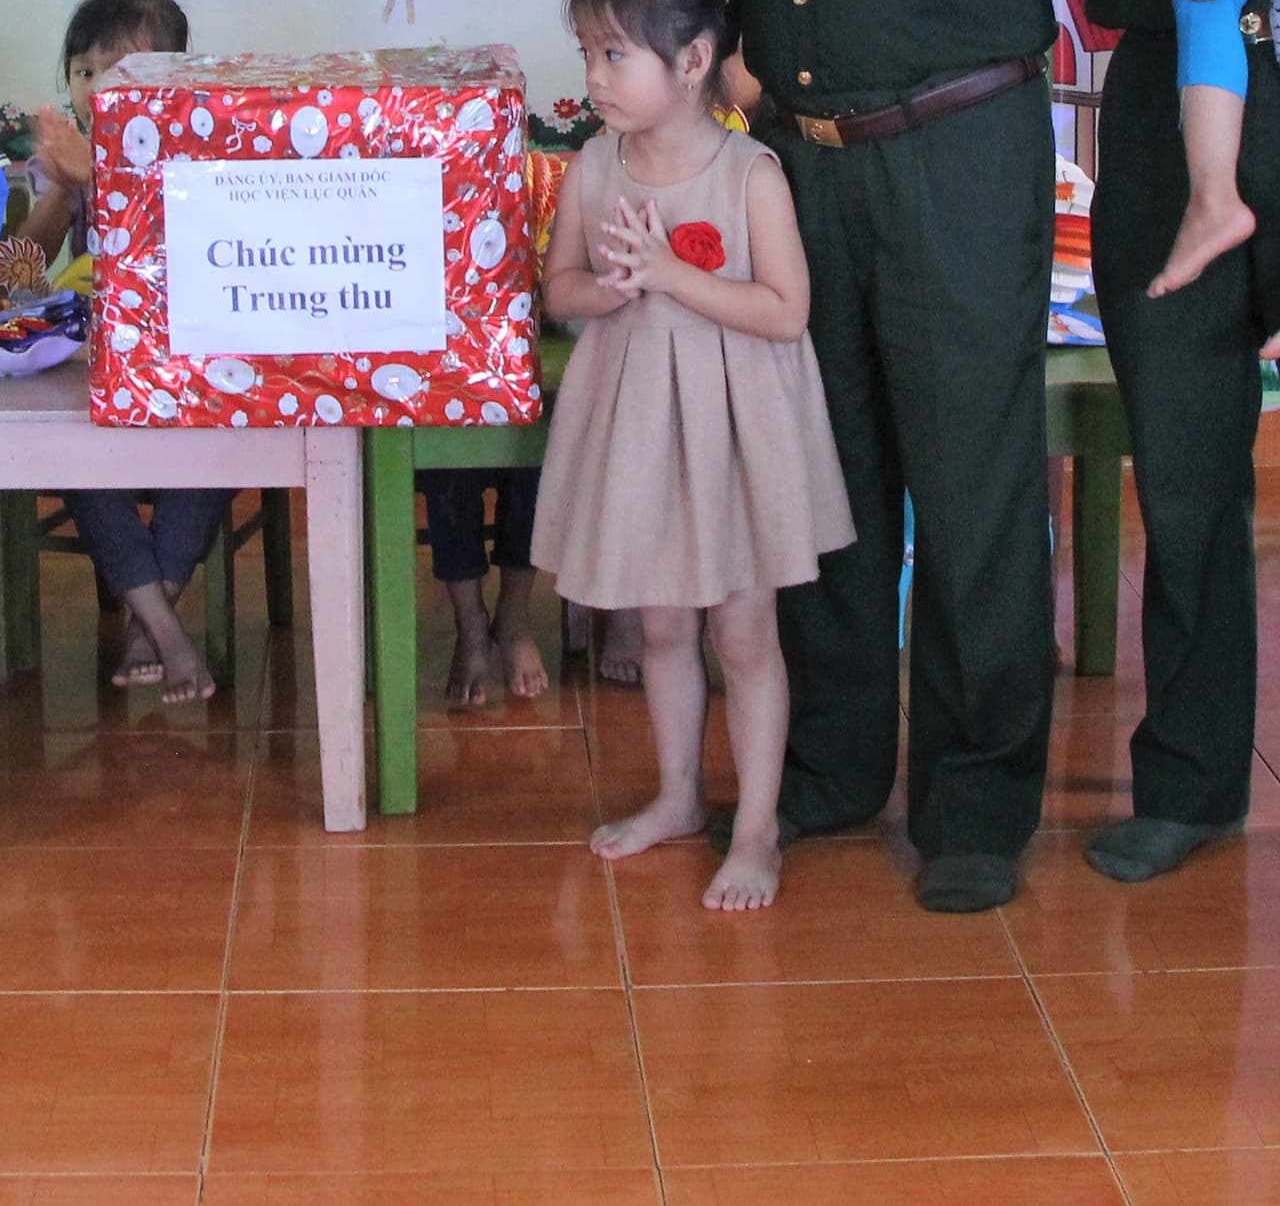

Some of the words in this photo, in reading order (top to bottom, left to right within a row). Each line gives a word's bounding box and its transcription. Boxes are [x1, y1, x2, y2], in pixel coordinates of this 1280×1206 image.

[286, 173, 314, 184] BAN
[318, 170, 356, 183] GIÁM
[229, 190, 258, 203] HỌC
[265, 187, 299, 202] VIỆN
[336, 184, 379, 200] QUÂN
[207, 238, 296, 268] Chúc
[309, 235, 407, 271] mừng
[222, 285, 328, 318] Trung
[339, 283, 392, 310] thu
